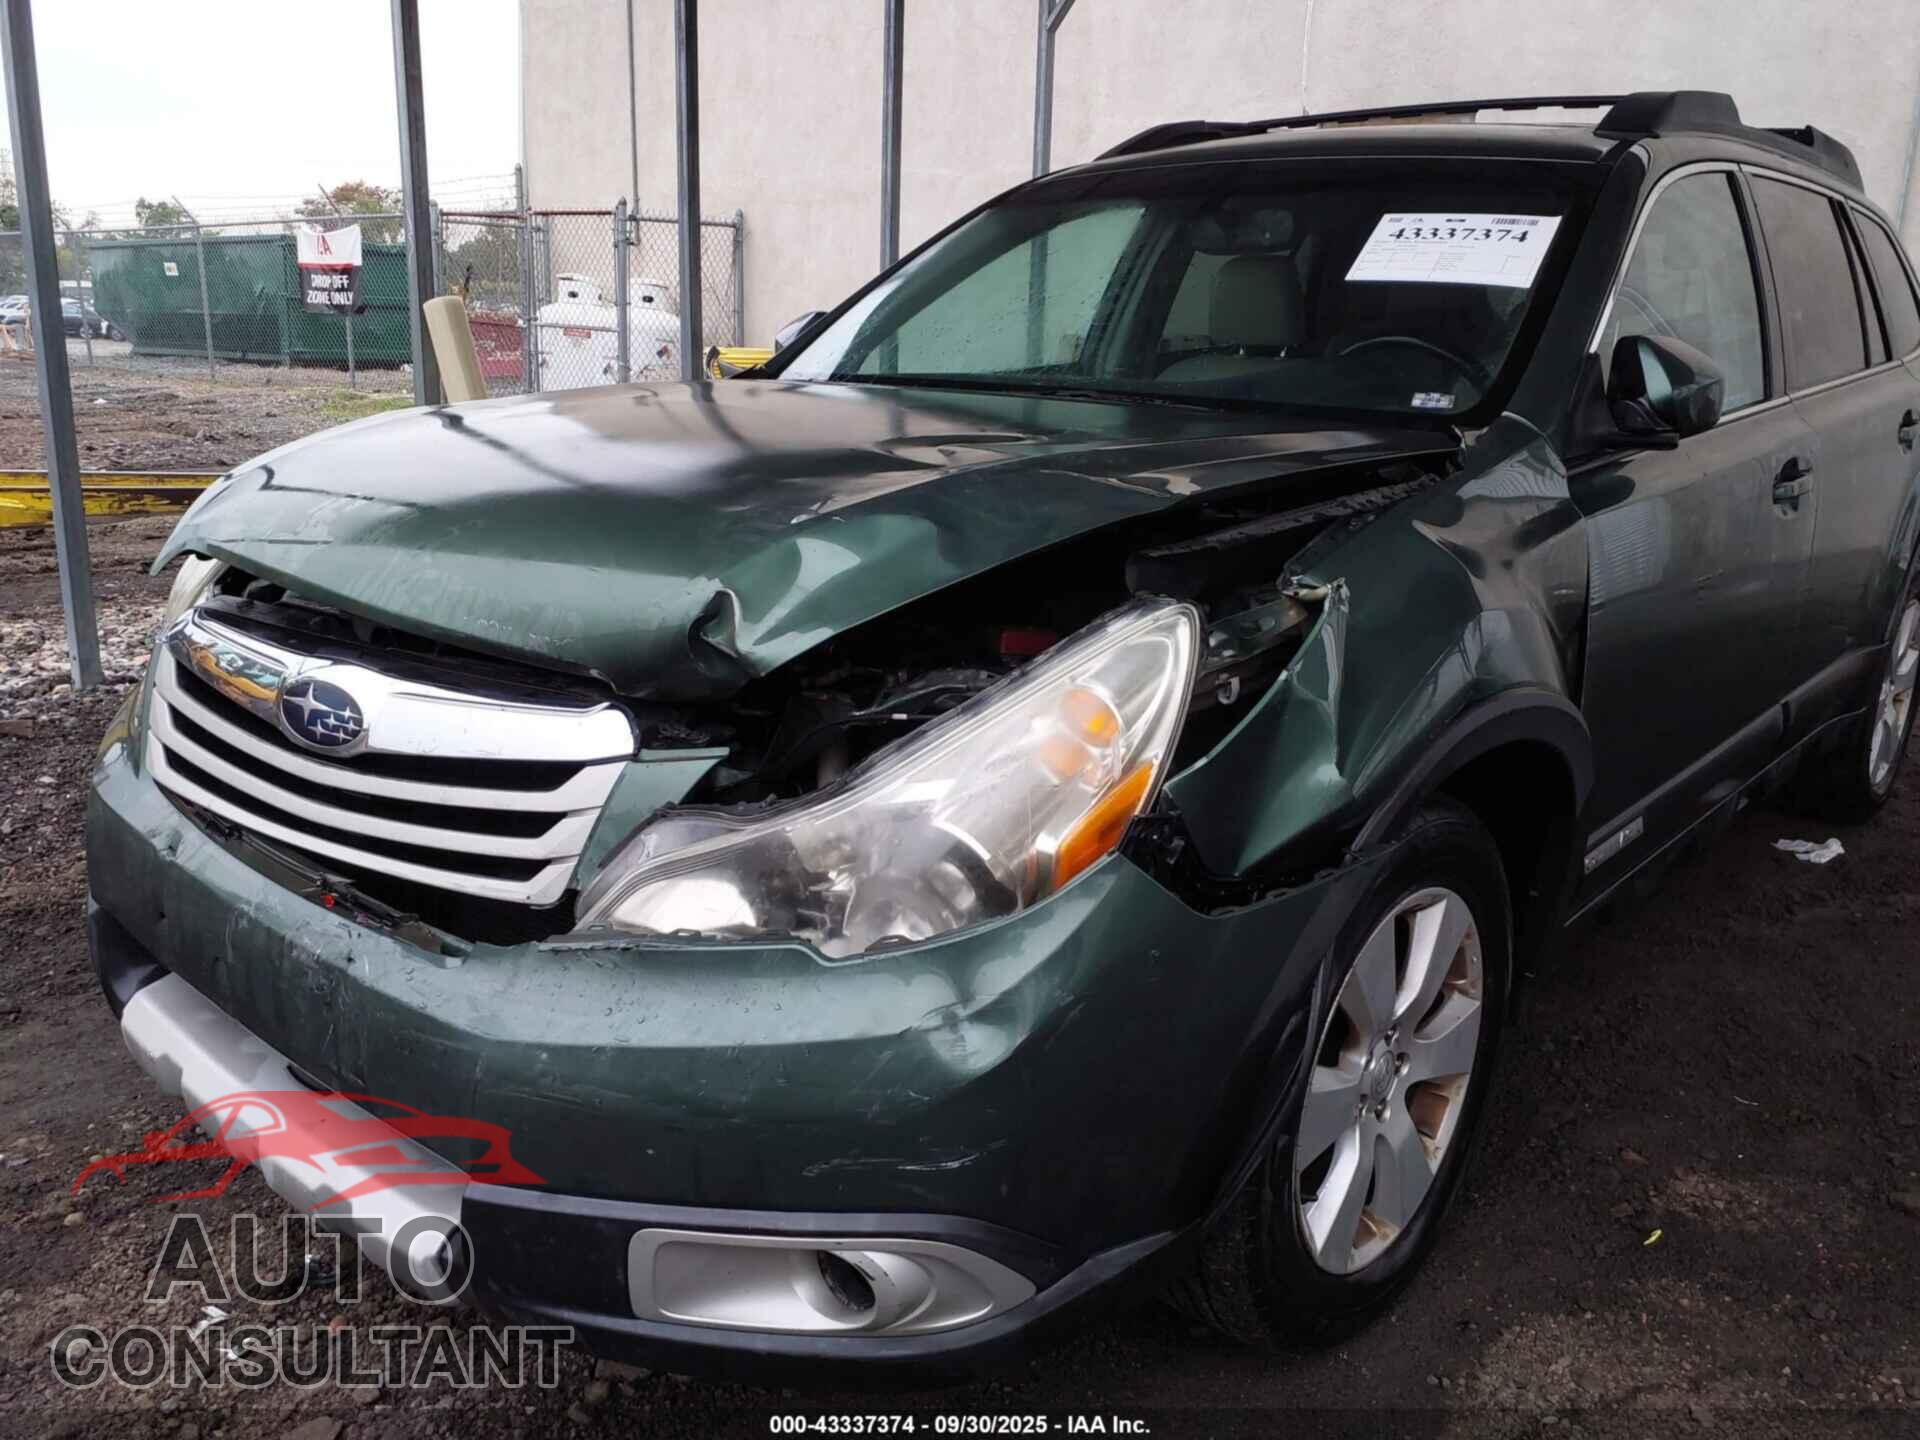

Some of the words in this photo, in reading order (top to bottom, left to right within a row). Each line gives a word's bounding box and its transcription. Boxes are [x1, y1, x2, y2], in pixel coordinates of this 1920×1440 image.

[1389, 227, 1529, 242] 43337374
[311, 274, 331, 288] DROP
[332, 275, 349, 289] OFF
[307, 290, 330, 304] ZONE
[330, 291, 354, 305] ONLY
